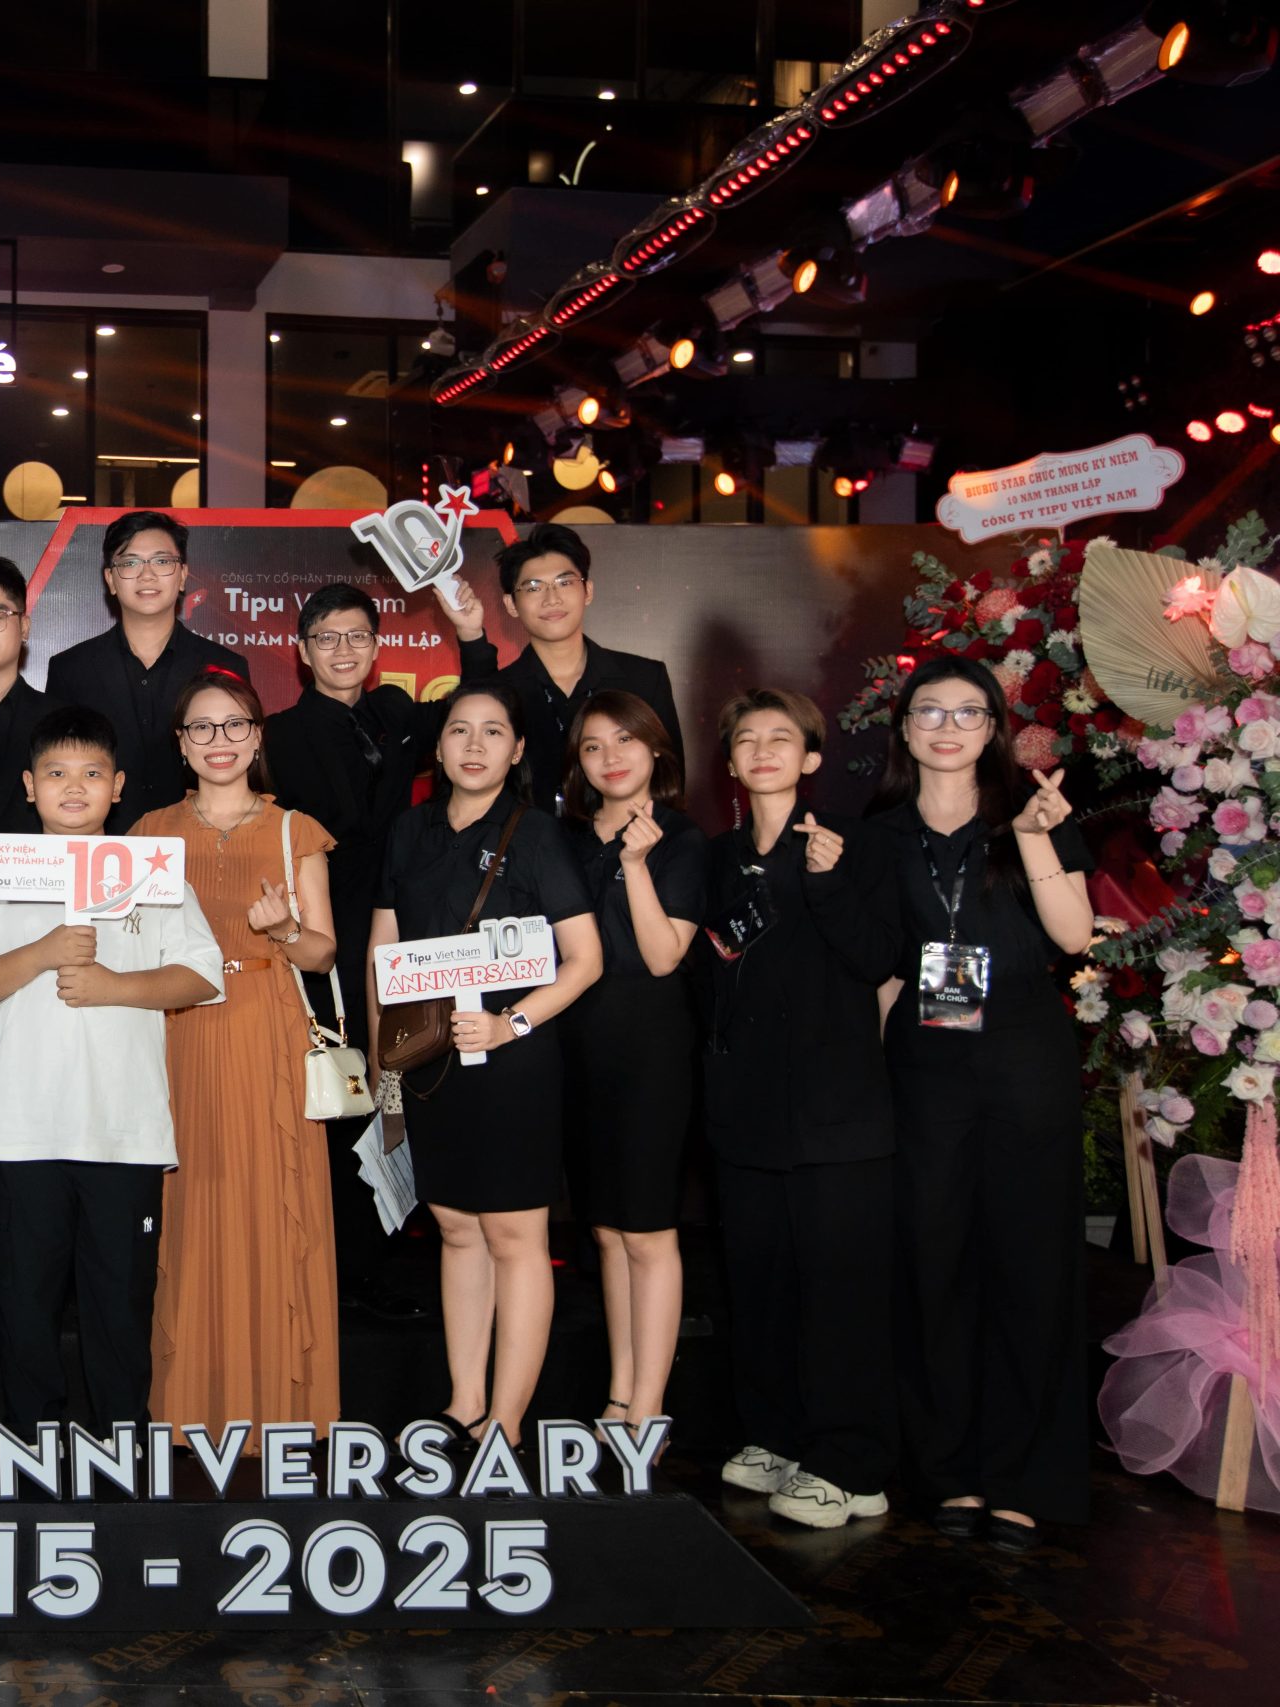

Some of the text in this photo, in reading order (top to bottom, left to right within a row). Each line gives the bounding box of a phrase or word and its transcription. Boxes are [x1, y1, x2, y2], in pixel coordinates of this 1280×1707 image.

[965, 482, 998, 498] BIUBIU
[1001, 475, 1026, 490] STAR
[981, 488, 1138, 528] CÔNG TY TIPU VIỆT NAM
[1008, 496, 1018, 505] 10
[358, 504, 458, 588] 10
[221, 571, 253, 584] CÔNG
[256, 573, 271, 584] TY
[273, 571, 289, 584] CỔ
[291, 571, 322, 585] PHẦN
[325, 573, 352, 585] TIPU
[354, 572, 378, 585] VIỆT
[224, 587, 284, 621] Tipu
[219, 632, 237, 646] 10
[244, 630, 283, 646] NĂM
[408, 631, 441, 650] LẬP
[13, 844, 36, 855] NIỆM
[12, 855, 45, 865] THÀNH
[47, 856, 65, 867] LẬP
[15, 876, 37, 887] Viet
[39, 876, 65, 888] Nam
[67, 841, 133, 913] 10
[407, 952, 432, 966] Tipu
[435, 950, 455, 961] Viet
[457, 947, 481, 958] Nam
[386, 957, 548, 995] ANNIVERSARY
[944, 986, 961, 994] BAN
[947, 993, 969, 1003] CHỨC
[143, 1558, 181, 1588] -
[216, 1515, 554, 1618] 2025
